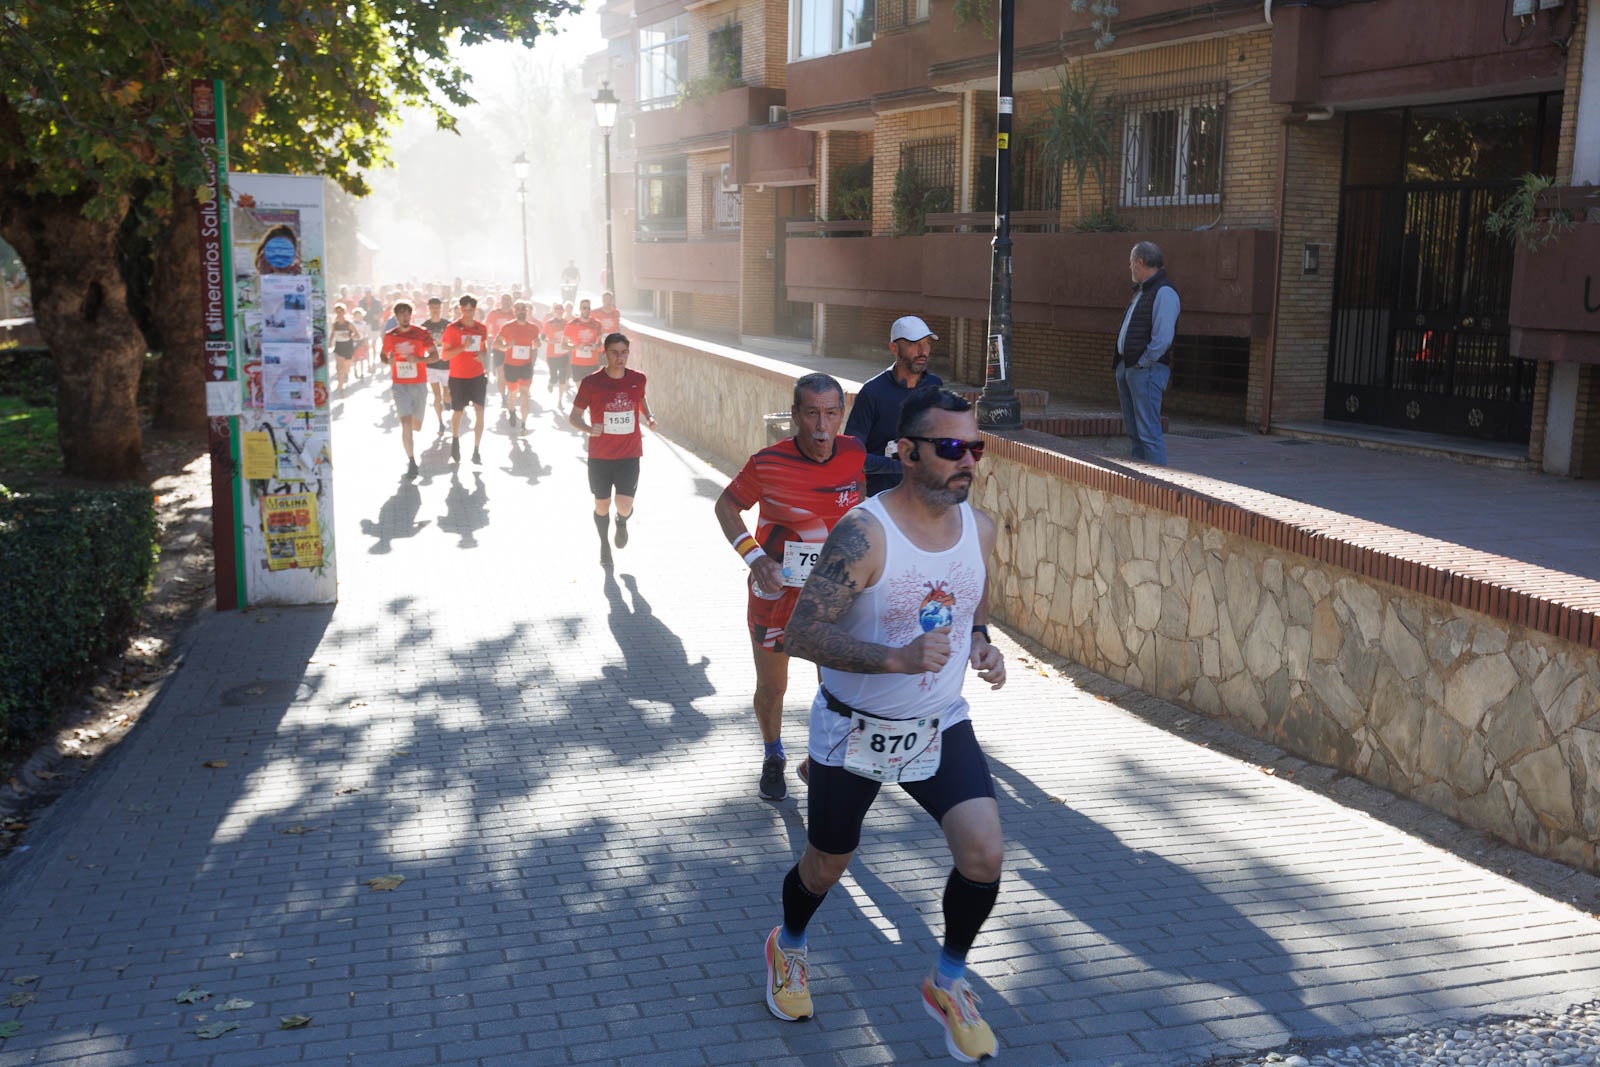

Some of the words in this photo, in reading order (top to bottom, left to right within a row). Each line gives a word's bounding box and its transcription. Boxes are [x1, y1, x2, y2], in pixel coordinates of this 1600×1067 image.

[200, 137, 218, 236] Saludas
[202, 242, 221, 326] tinerarios
[870, 732, 918, 754] 870
